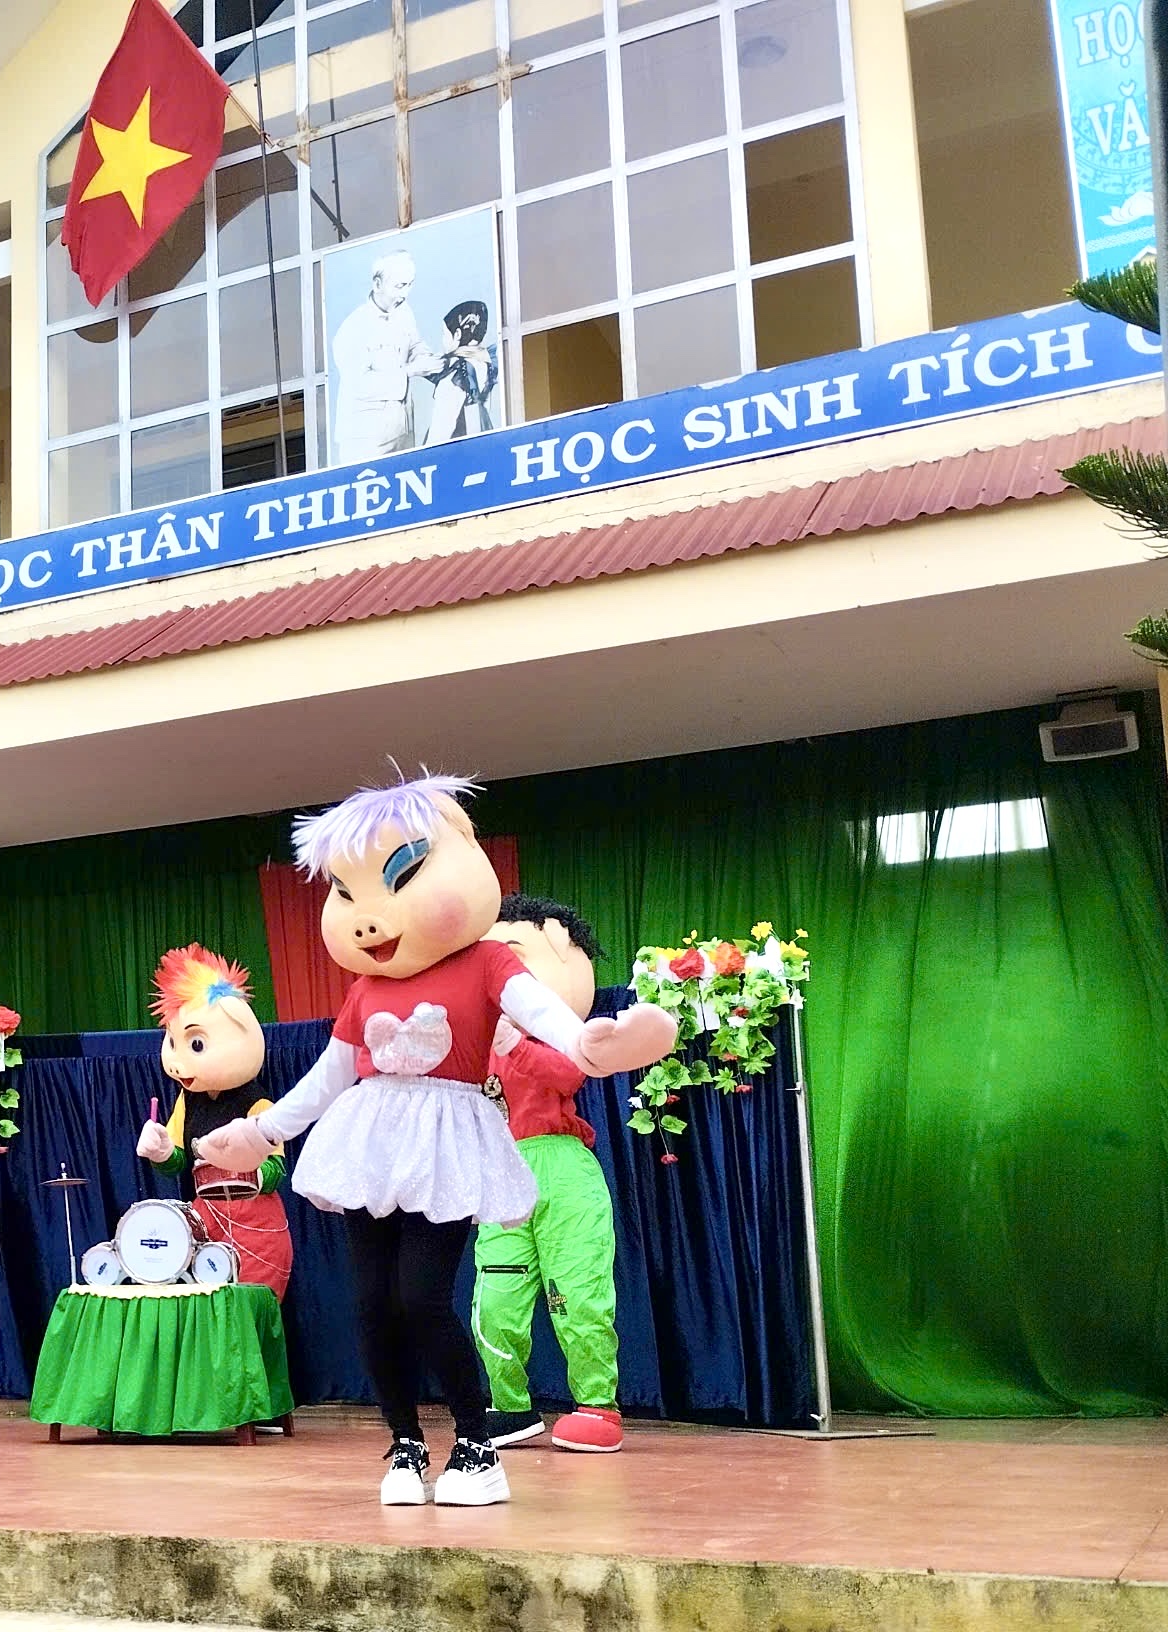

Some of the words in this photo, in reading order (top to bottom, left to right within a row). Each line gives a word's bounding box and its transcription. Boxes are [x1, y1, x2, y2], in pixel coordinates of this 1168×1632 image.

[1073, 0, 1144, 68] HỌ
[1086, 80, 1150, 156] VĂ
[70, 511, 224, 578] THÂN
[244, 465, 437, 542] THIỆN
[510, 418, 657, 486] HỌC
[683, 372, 862, 451] SINH
[887, 322, 1094, 405] TÍCH
